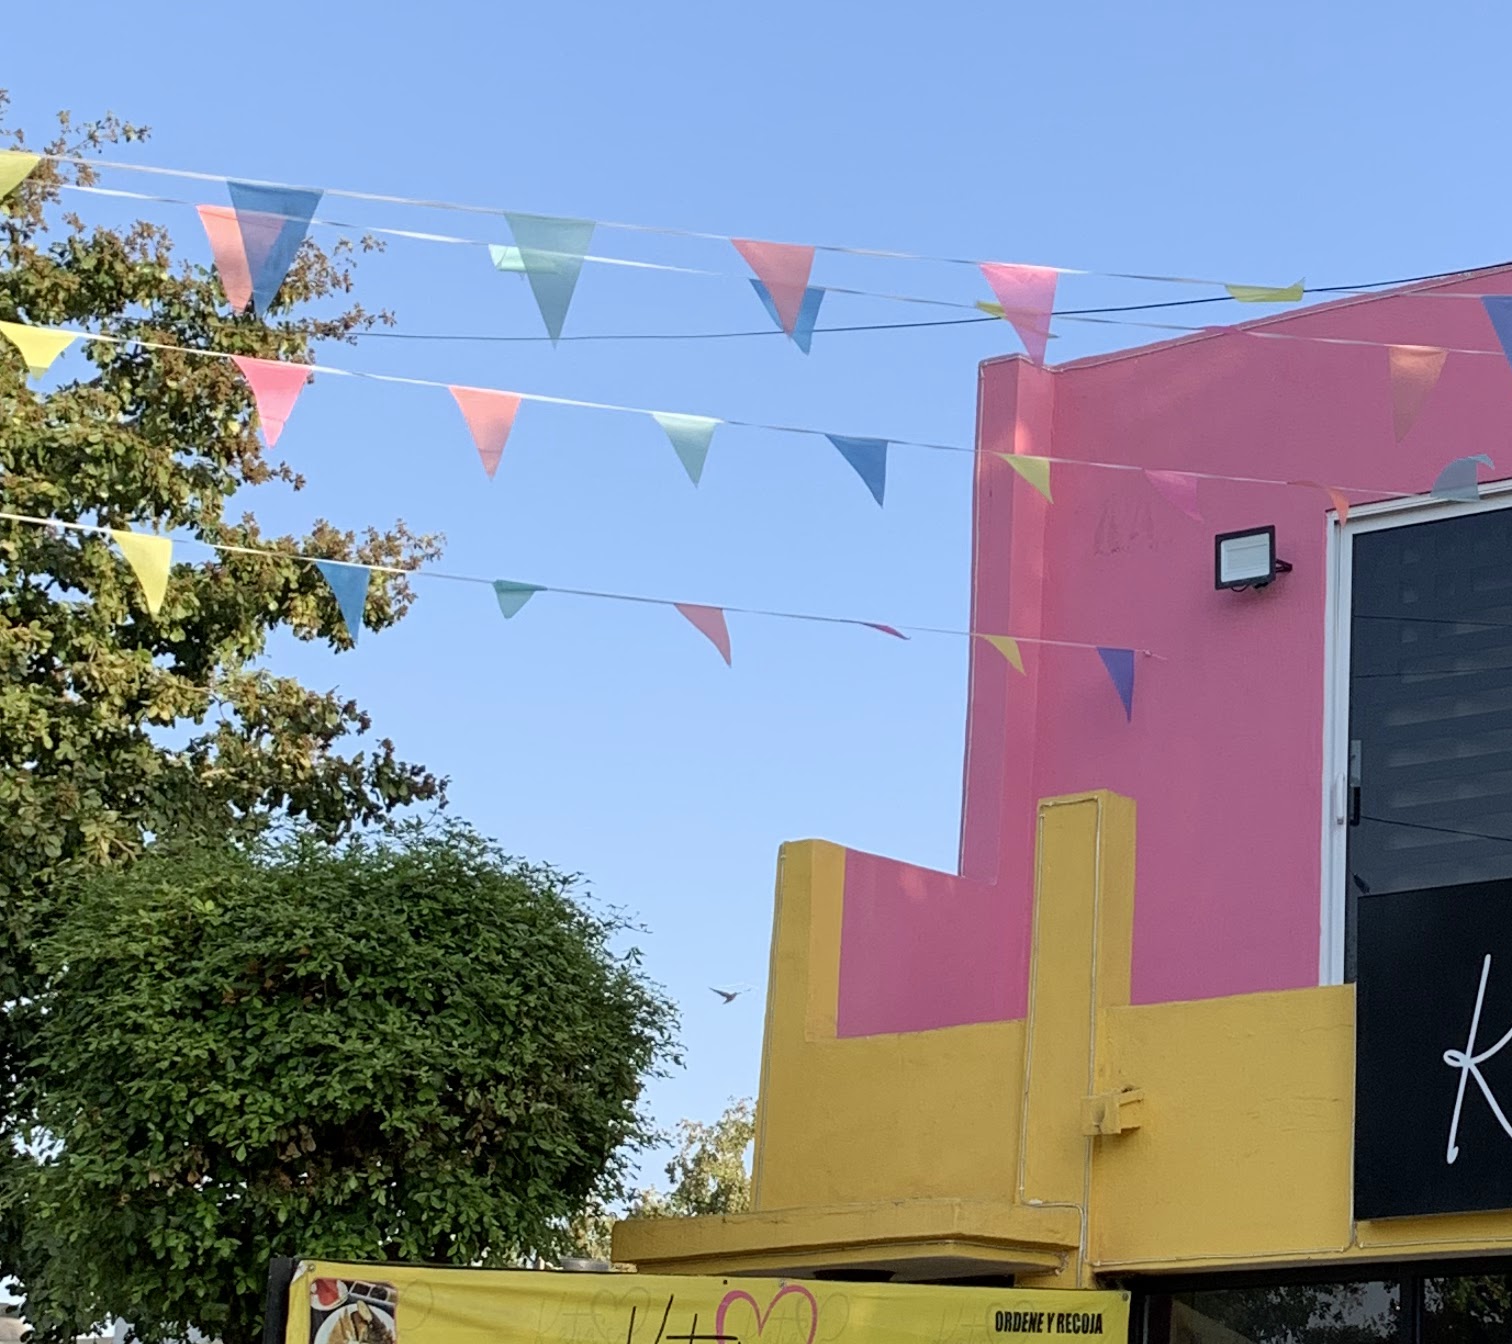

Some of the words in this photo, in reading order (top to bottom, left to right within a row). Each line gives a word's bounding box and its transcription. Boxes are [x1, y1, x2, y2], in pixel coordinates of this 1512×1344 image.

[995, 1310, 1044, 1333] ORDENE
[1046, 1312, 1055, 1333] Y
[1056, 1313, 1103, 1334] RECOJA
